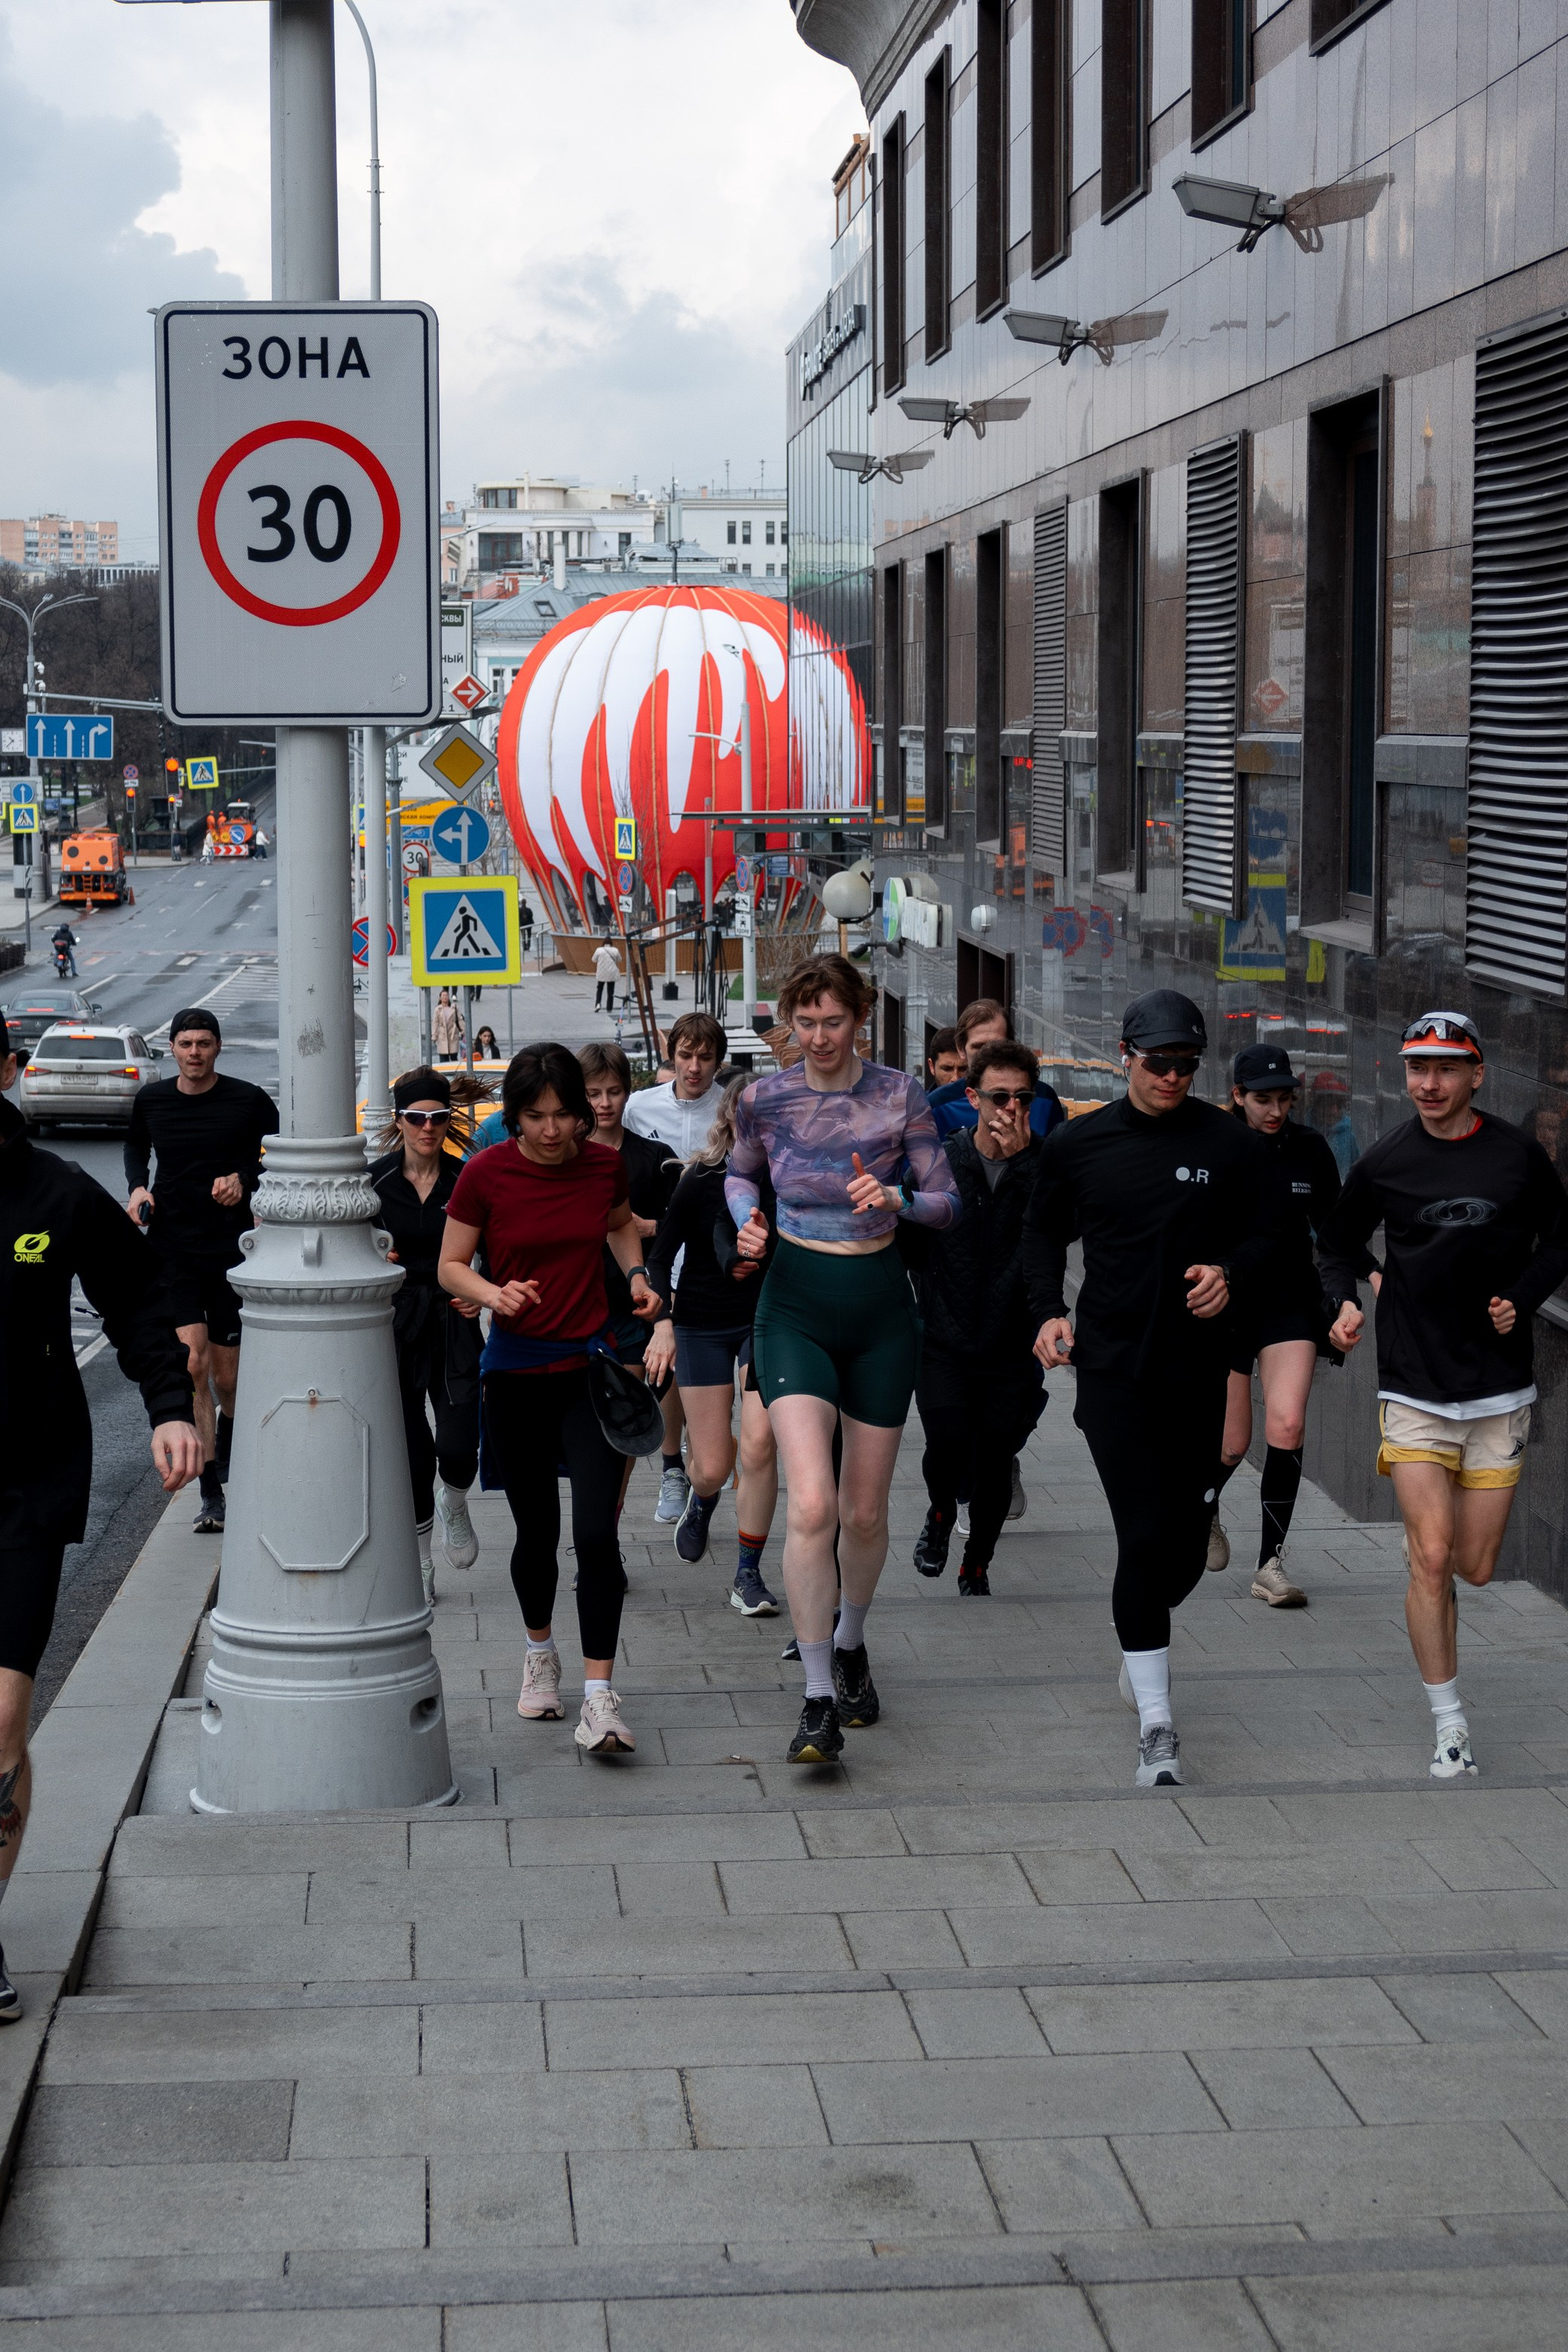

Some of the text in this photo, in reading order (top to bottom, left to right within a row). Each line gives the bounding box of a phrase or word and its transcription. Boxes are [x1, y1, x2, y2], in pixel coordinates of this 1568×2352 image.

[222, 335, 371, 380] ЗОНА
[247, 484, 352, 563] 30
[407, 851, 424, 865] 30
